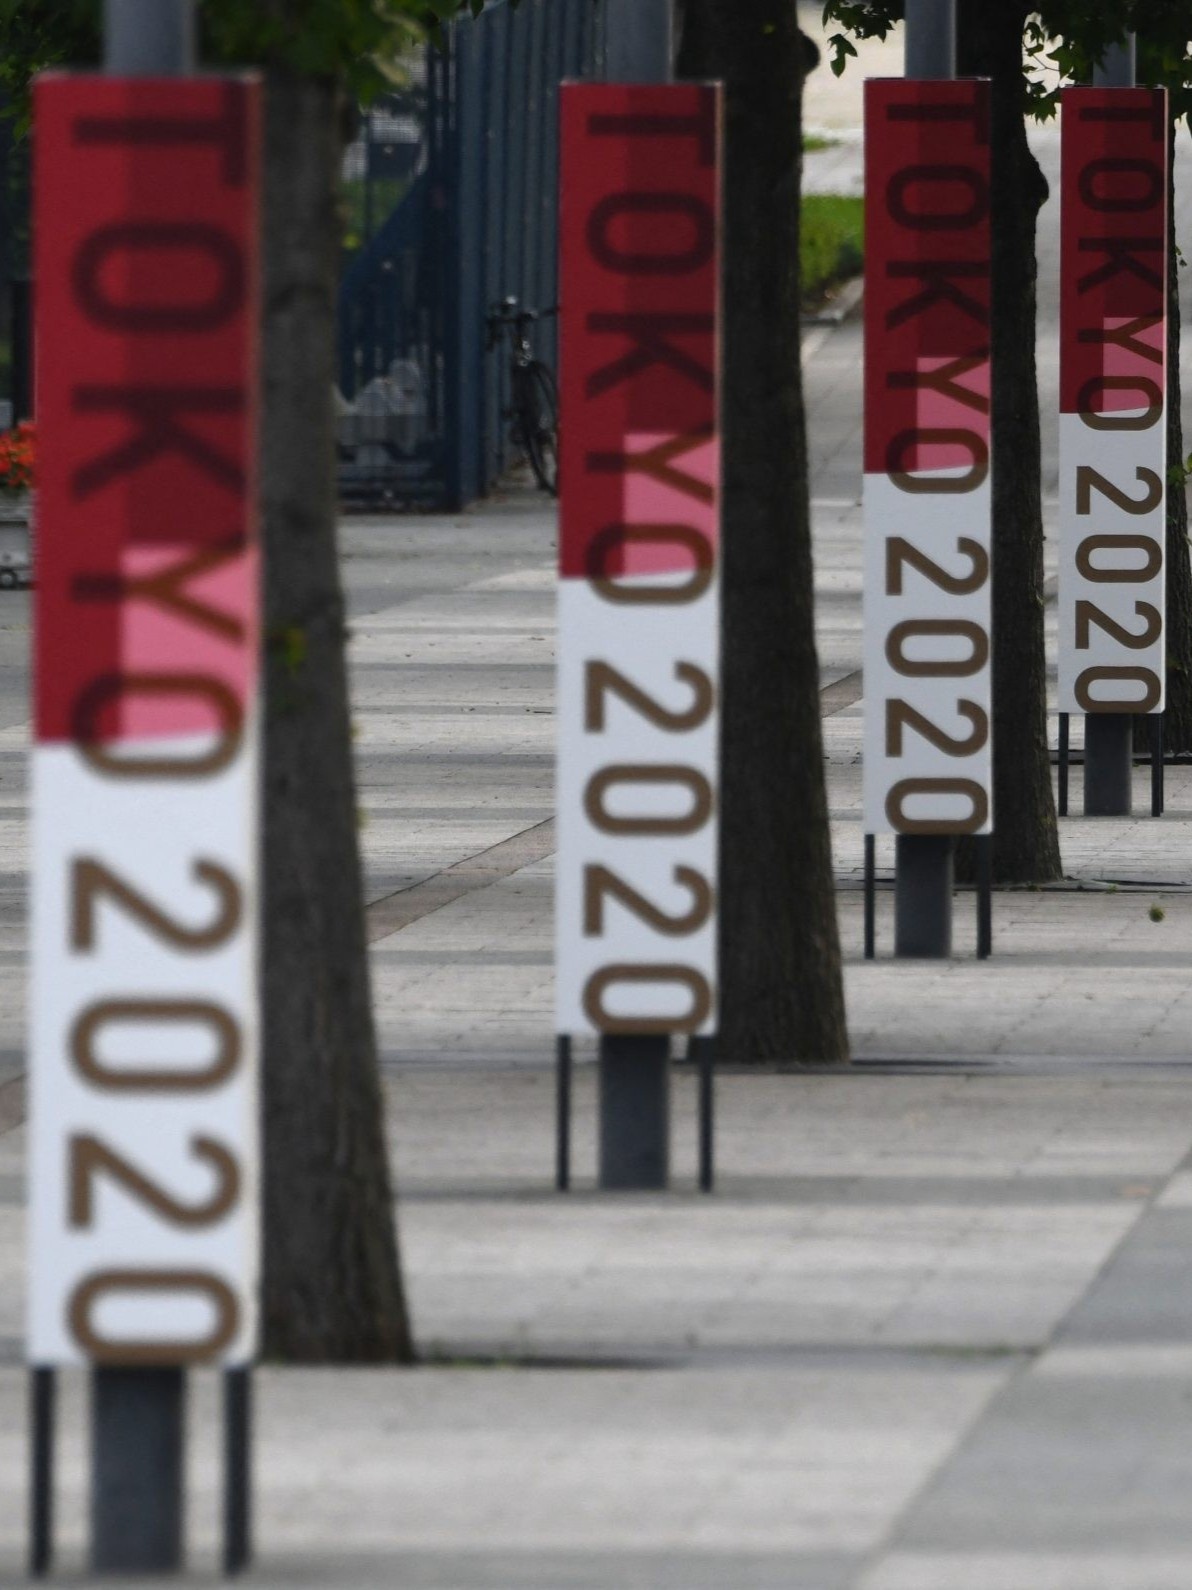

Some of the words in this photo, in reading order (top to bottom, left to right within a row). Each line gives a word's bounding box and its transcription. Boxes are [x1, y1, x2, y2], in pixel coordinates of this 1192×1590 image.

[72, 79, 247, 782] TOKYO
[586, 84, 715, 606] TOKYO
[885, 82, 990, 494] TOKYO
[1077, 87, 1163, 431] TOKYO
[885, 536, 989, 834] 2020
[1074, 466, 1162, 713] 2020
[582, 660, 714, 1034] 2020
[66, 854, 244, 1365] 2020
